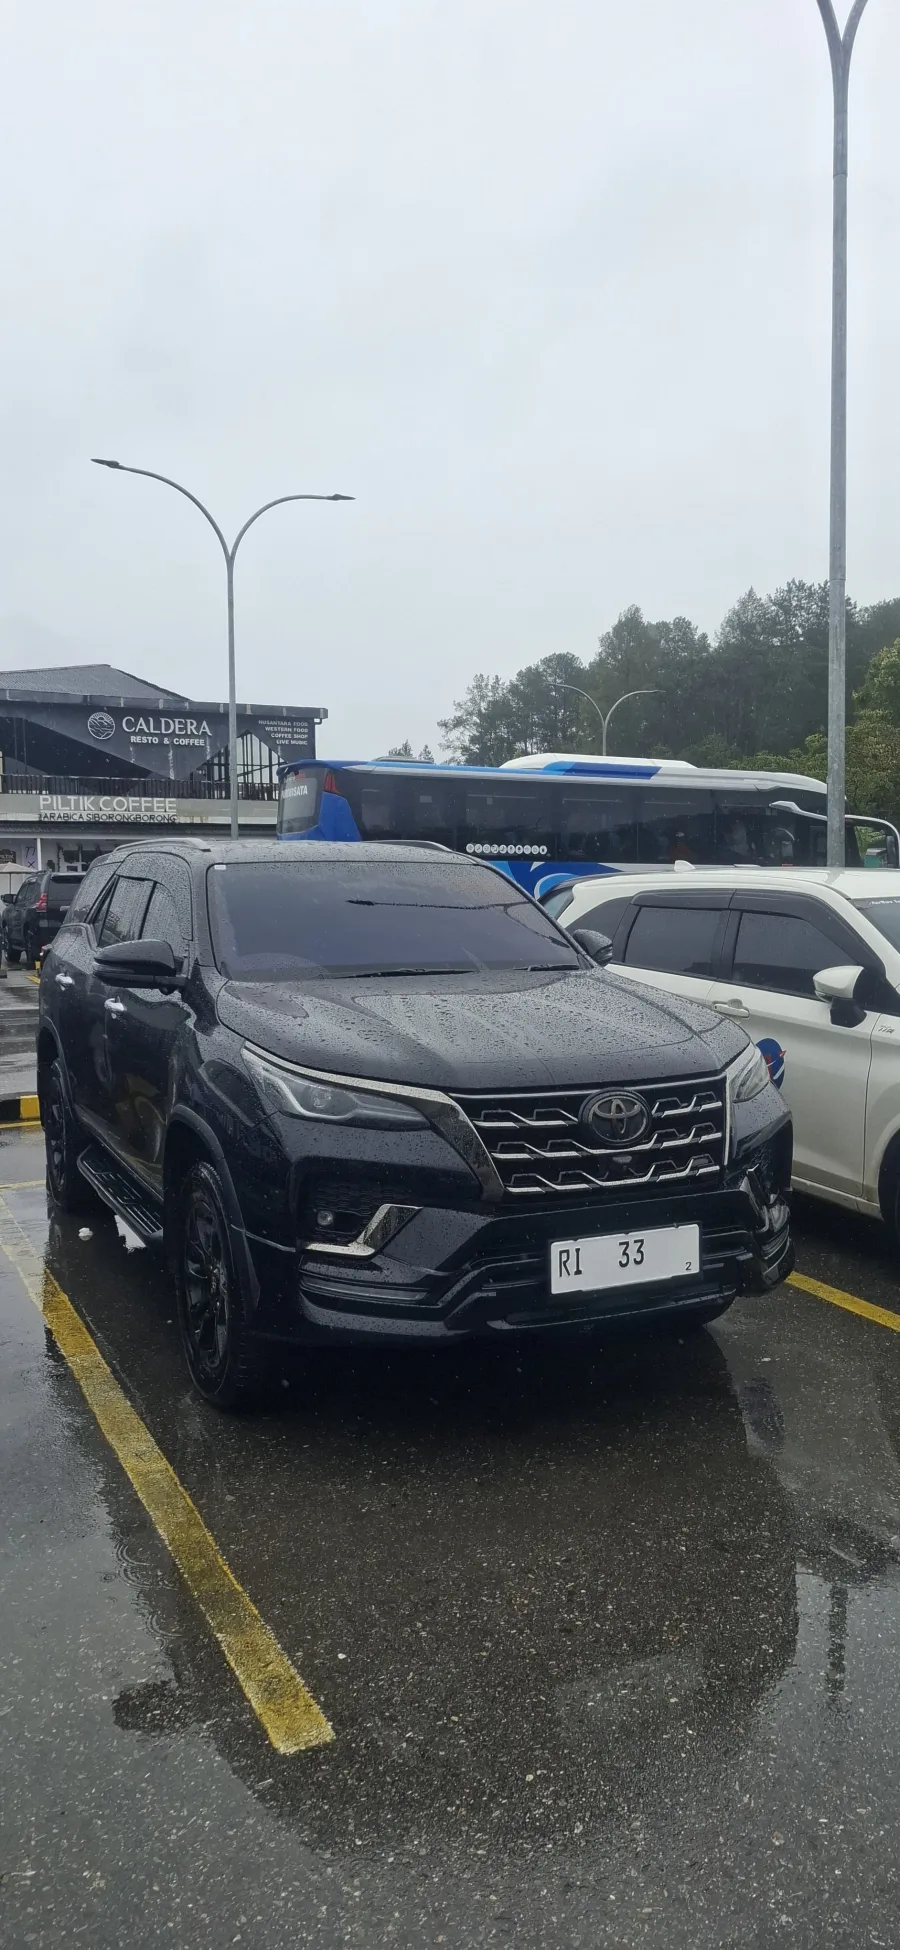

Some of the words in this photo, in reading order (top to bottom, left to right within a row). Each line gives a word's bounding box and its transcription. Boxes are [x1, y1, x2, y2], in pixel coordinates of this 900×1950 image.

[122, 716, 213, 736] CALDERA
[130, 735, 159, 744] RESTO
[173, 738, 205, 746] COFFEE
[39, 795, 95, 811] PILTIK
[99, 796, 177, 812] COFFEE
[42, 812, 83, 821] ARABICA
[86, 813, 177, 823] SIBORONGBORONG
[558, 1247, 583, 1277] RI
[618, 1239, 645, 1268] 33
[685, 1261, 692, 1271] 2
